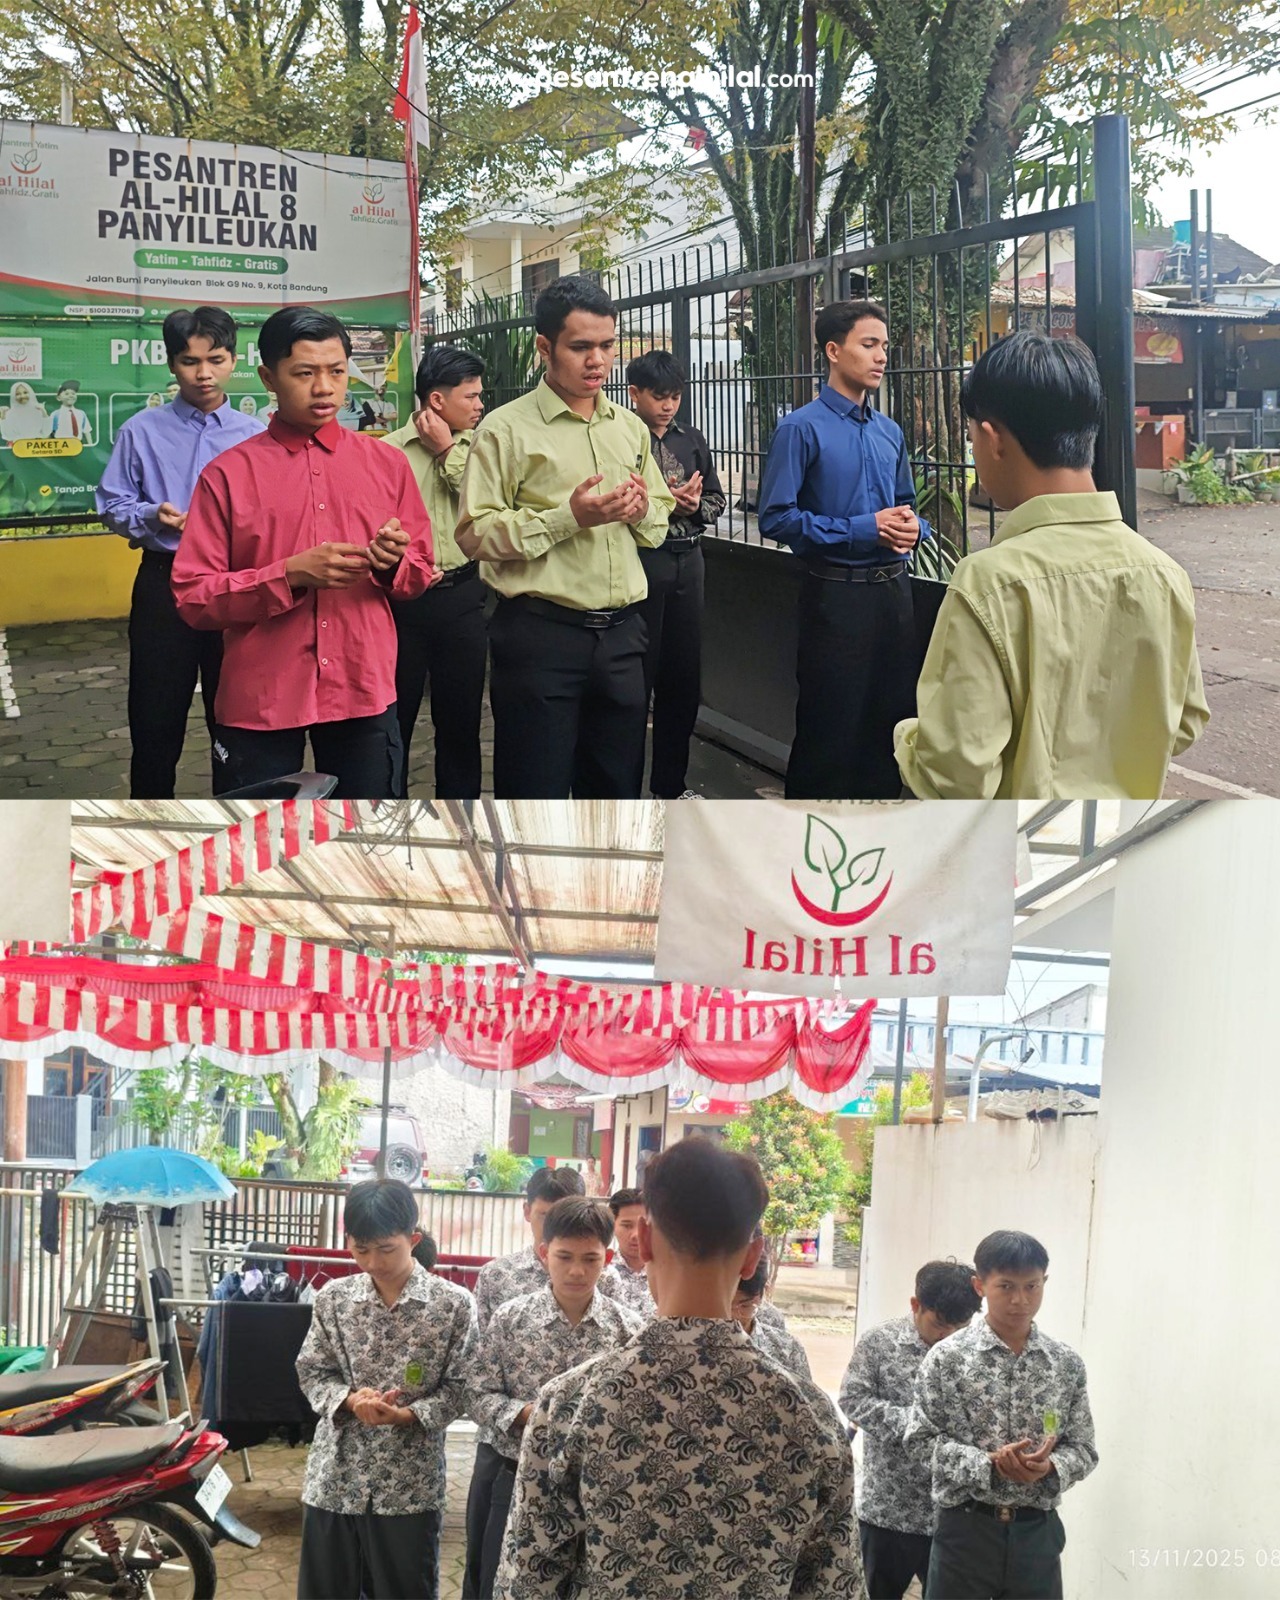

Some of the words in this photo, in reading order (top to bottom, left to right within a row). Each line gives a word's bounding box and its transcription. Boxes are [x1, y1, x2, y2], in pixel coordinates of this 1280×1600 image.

[109, 148, 297, 192] PESANTREN
[18, 176, 55, 190] Hilal
[120, 180, 268, 219] AL-HILAL
[280, 194, 297, 221] 8
[352, 205, 363, 215] al
[367, 205, 395, 218] Hilal
[98, 209, 317, 251] PANYILEUKAN
[145, 252, 178, 265] Yatim
[191, 255, 232, 268] Tahfidz
[244, 258, 278, 271] Gratis
[86, 275, 114, 283] Jalan
[116, 276, 141, 284] Bumi
[144, 276, 202, 287] Panyileukan
[206, 279, 225, 287] Blok
[242, 281, 256, 289] No.
[258, 282, 266, 290] 9,
[267, 282, 288, 290] Kota
[289, 283, 328, 294] Bandung
[26, 441, 59, 449] PAKET
[54, 486, 85, 494] Tanpa
